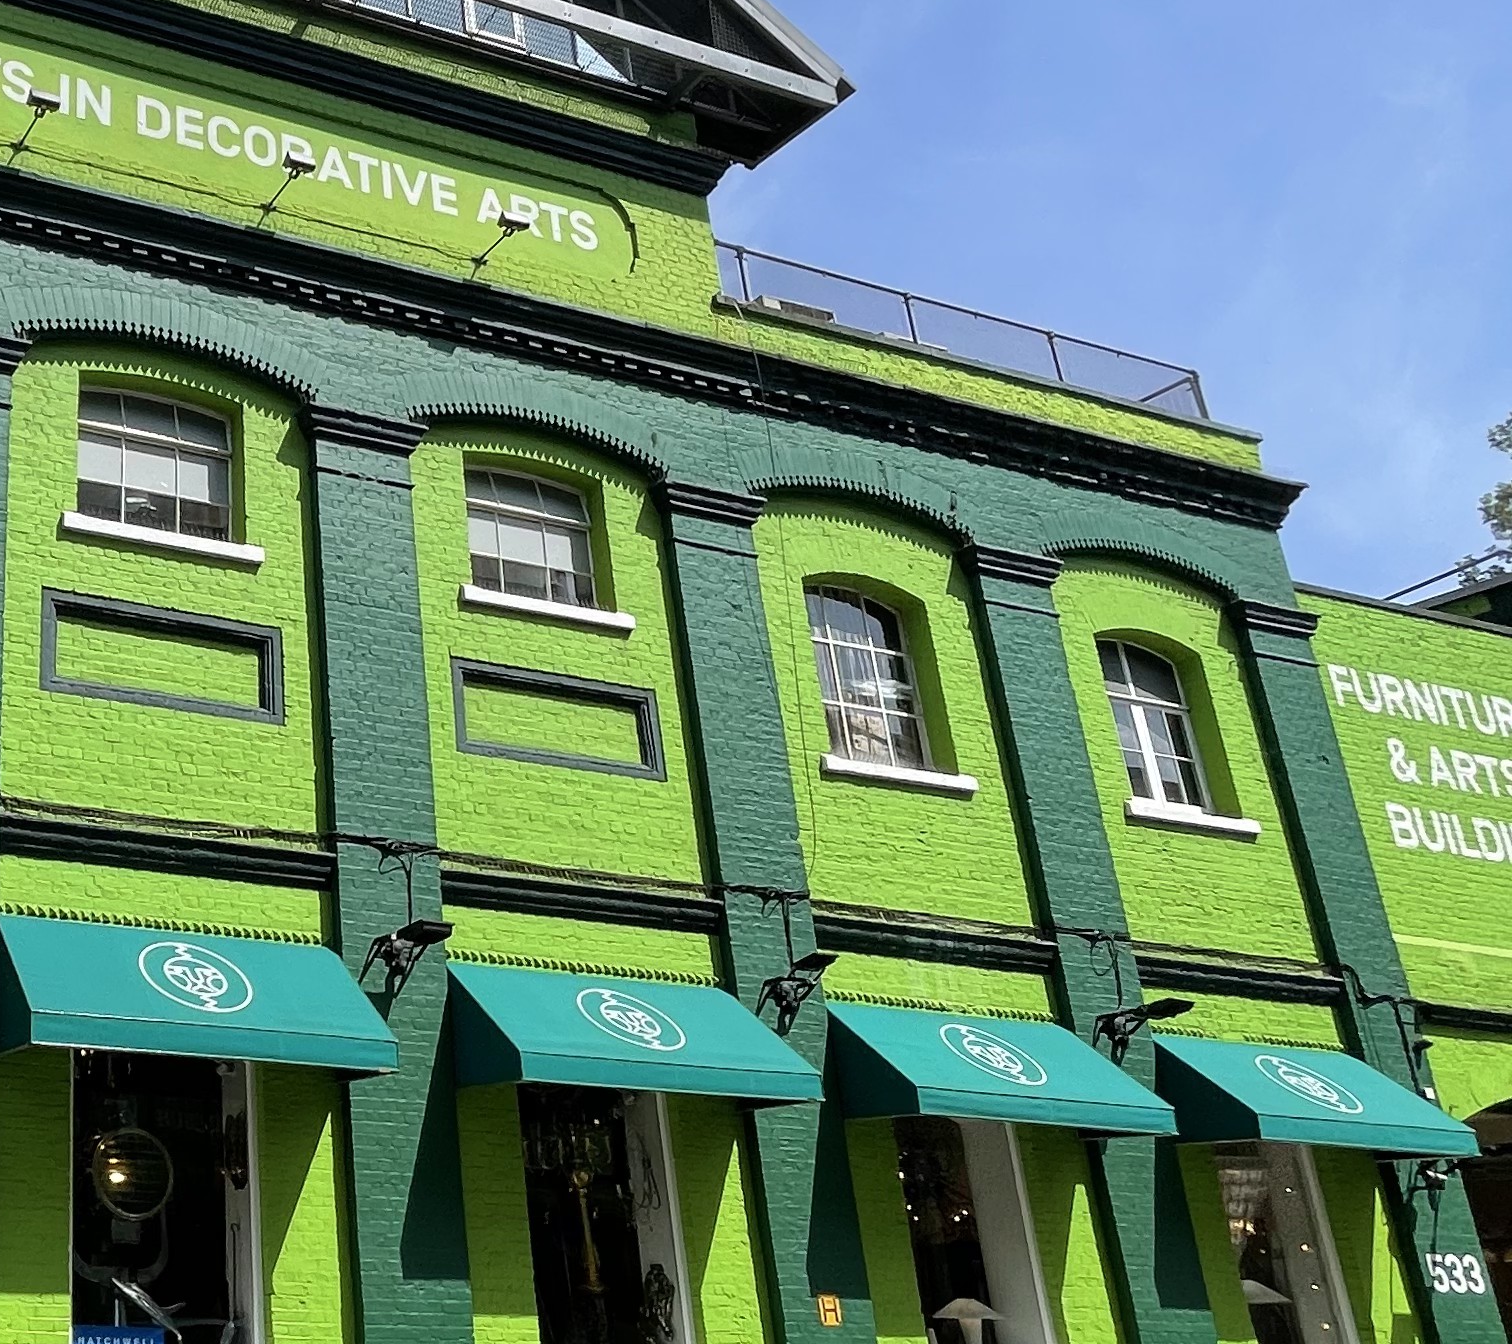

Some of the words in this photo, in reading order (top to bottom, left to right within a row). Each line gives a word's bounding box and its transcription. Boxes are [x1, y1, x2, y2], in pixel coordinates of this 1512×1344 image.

[58, 73, 112, 127] IN
[136, 94, 460, 217] DECORATIVE
[477, 187, 599, 251] ARTS
[1387, 737, 1424, 786] &
[1385, 801, 1512, 864] BUILDI
[1425, 1253, 1486, 1294] 533
